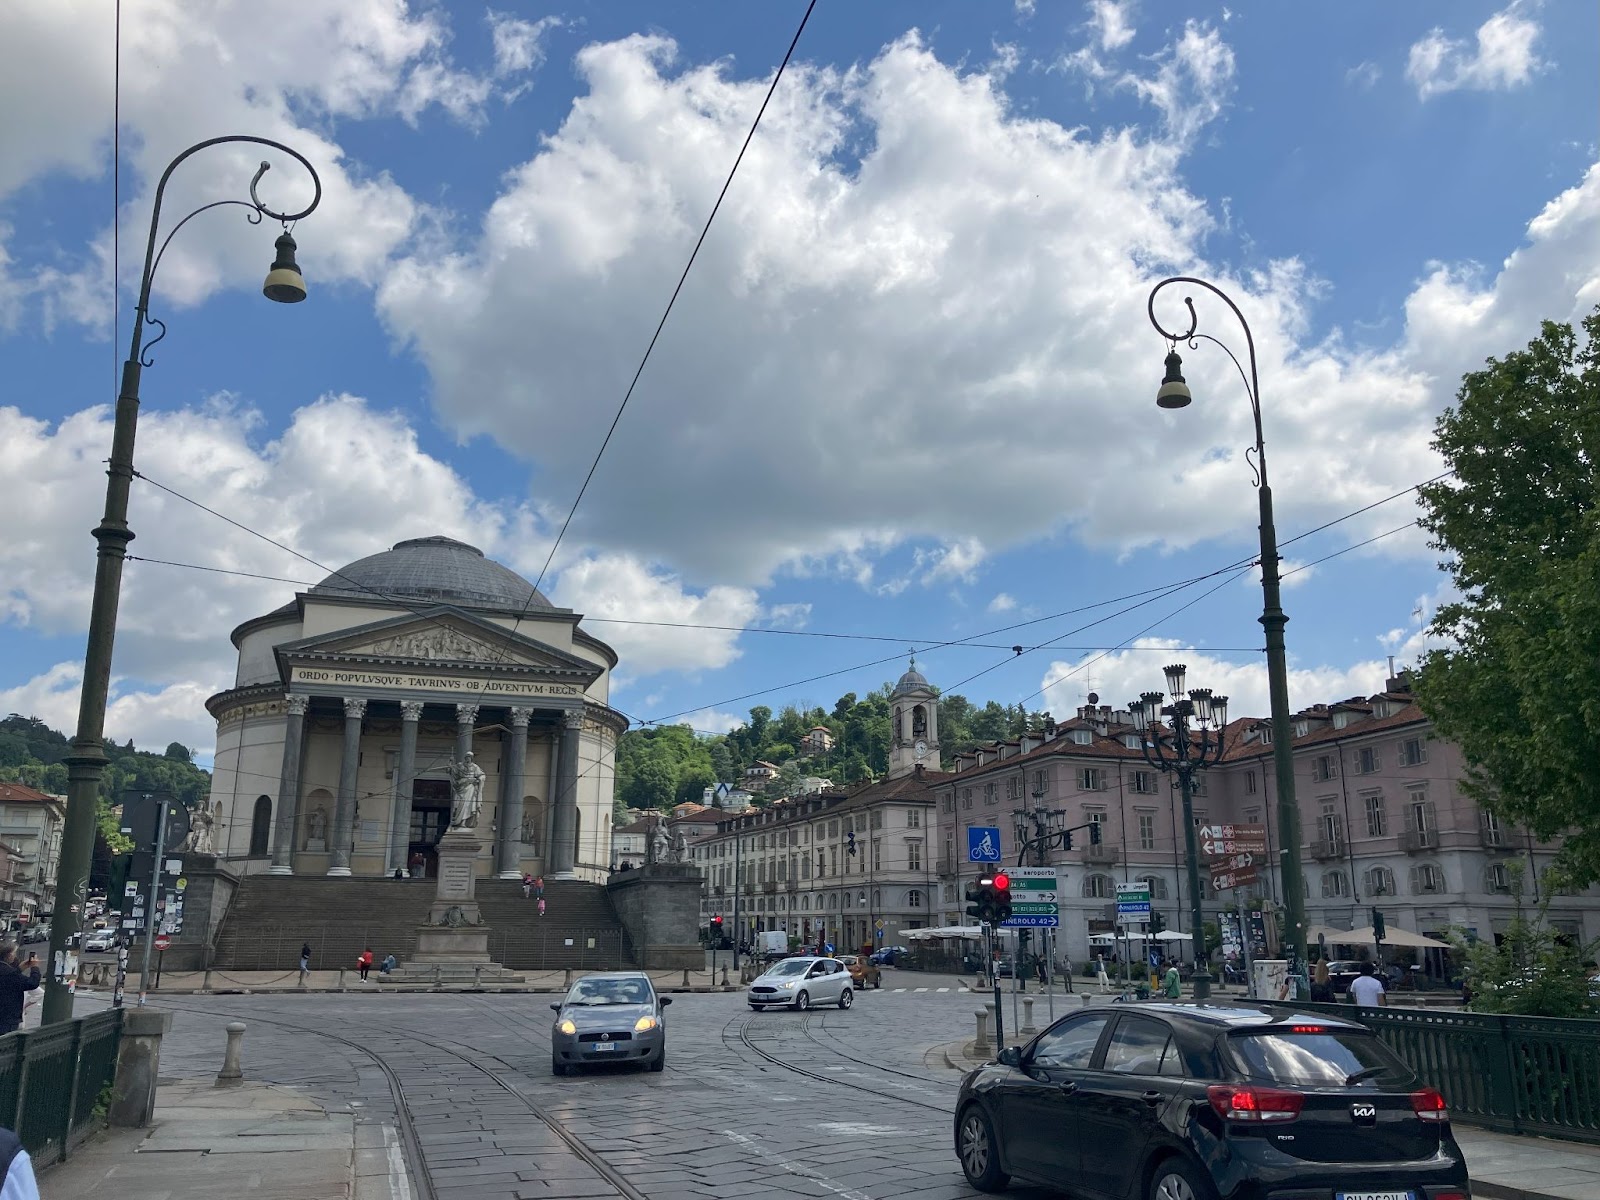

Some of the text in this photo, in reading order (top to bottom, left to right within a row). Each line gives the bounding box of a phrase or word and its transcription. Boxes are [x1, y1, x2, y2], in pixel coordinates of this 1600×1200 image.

[299, 671, 577, 695] ORDO POPVLVSQVE TAVRINVS OB ADVENTVM REGIS
[1353, 1107, 1375, 1116] KIA
